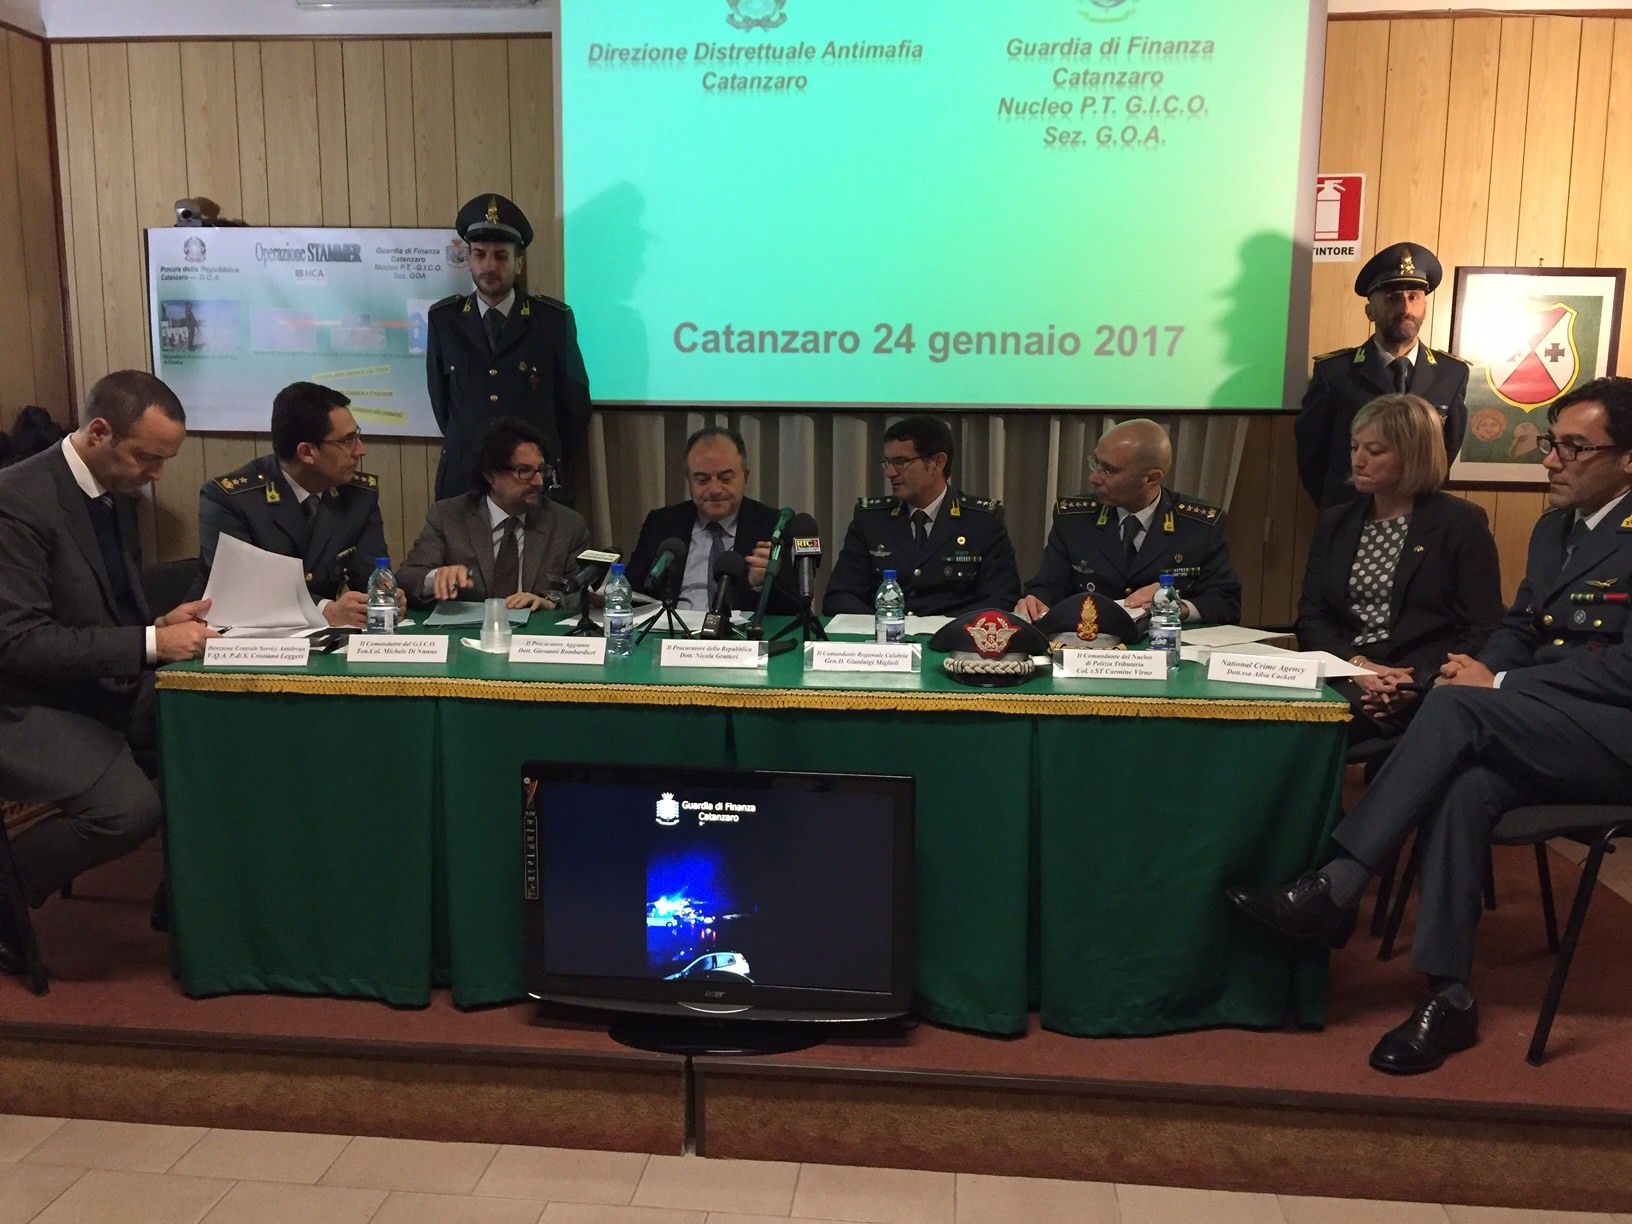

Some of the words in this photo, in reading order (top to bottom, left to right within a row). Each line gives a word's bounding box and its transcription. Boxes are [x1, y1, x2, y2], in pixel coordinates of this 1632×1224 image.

[588, 43, 688, 62] Direzione
[693, 42, 816, 61] Distrettuale
[821, 40, 924, 59] Antimafia
[1006, 37, 1093, 57] Guardia
[1100, 37, 1121, 55] di
[1127, 36, 1215, 55] Finanza
[701, 72, 808, 91] Catanzaro
[1052, 67, 1164, 87] Catanzaro
[998, 96, 1073, 116] Nucleo
[1079, 95, 1117, 114] P.T.
[1125, 94, 1209, 114] G.I.C.O.
[1043, 126, 1087, 145] Sez.
[1095, 125, 1166, 145] G.O.A.
[307, 243, 363, 262] STAMMER
[673, 322, 861, 354] Catanzaro
[873, 323, 916, 354] 24
[927, 324, 1082, 363] gennaio
[1093, 325, 1186, 357] 2017
[1222, 659, 1253, 668] National
[1253, 662, 1277, 670] Crime
[1279, 665, 1305, 674] Agency
[681, 800, 714, 811] Guardia
[714, 801, 724, 811] di
[724, 802, 757, 812] Finanza
[698, 811, 740, 822] Catanzaro
